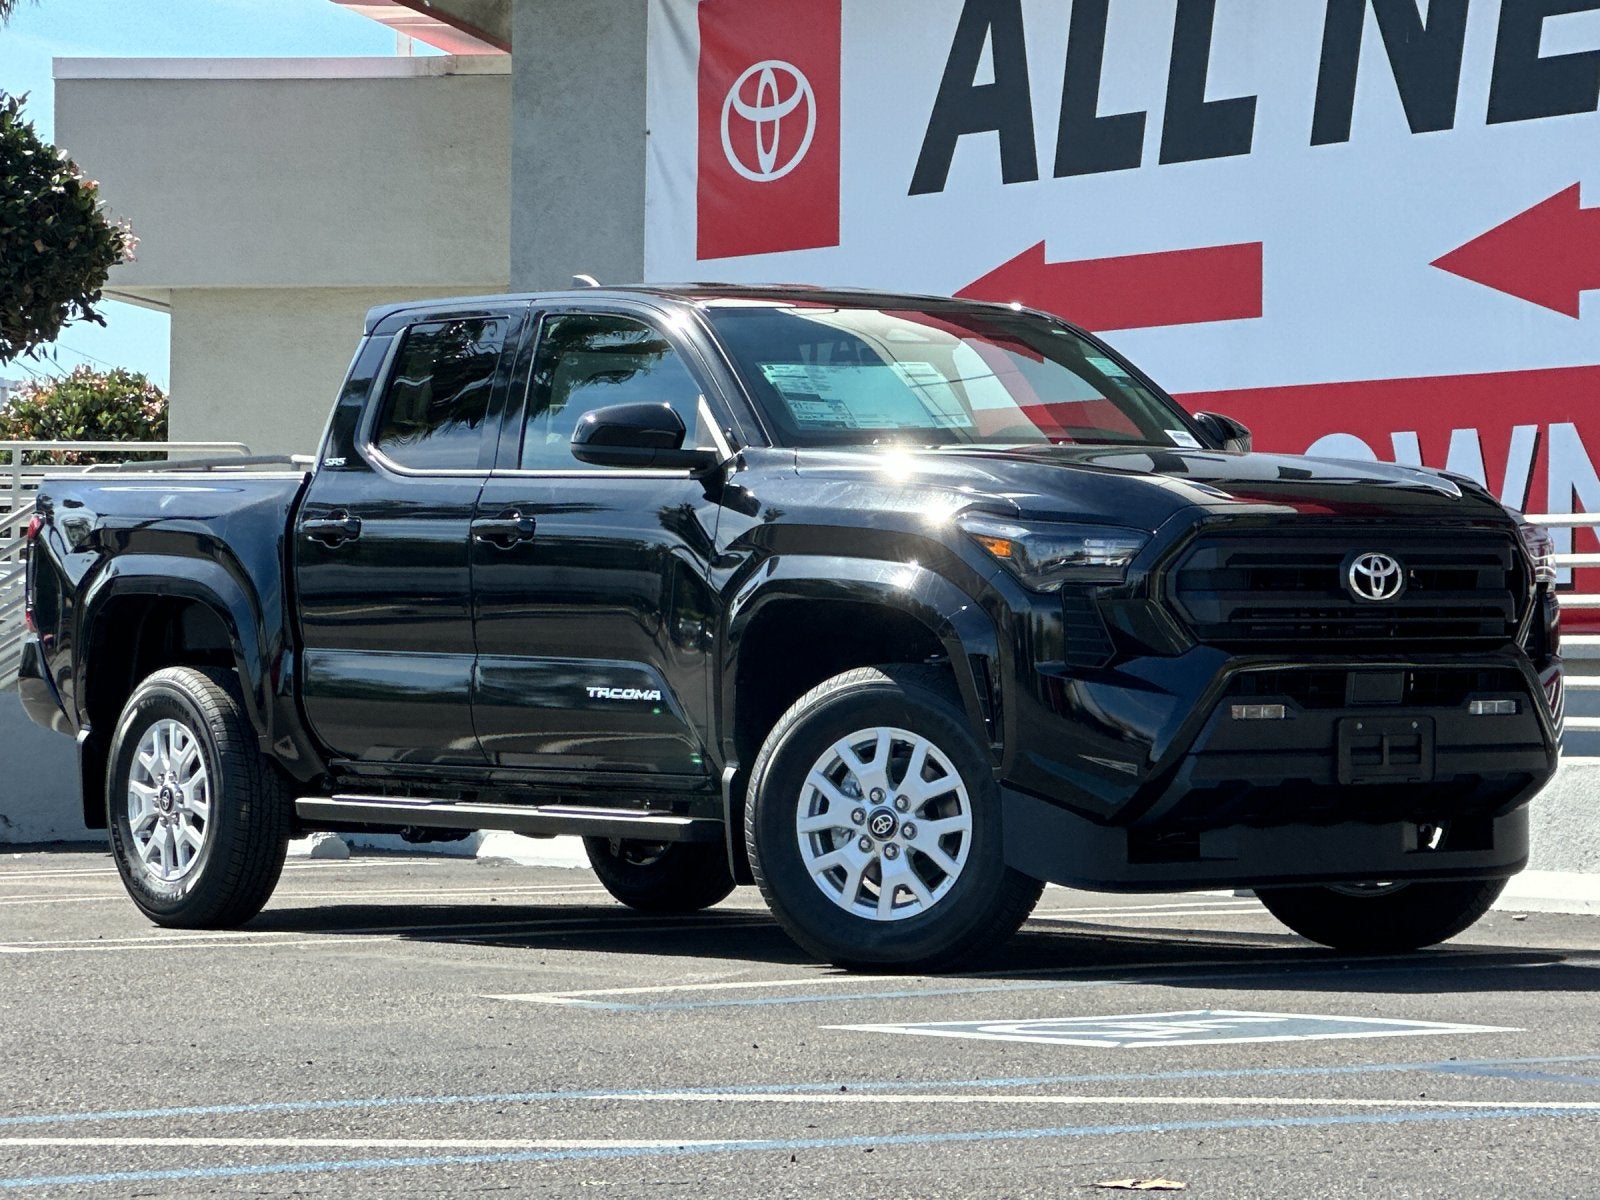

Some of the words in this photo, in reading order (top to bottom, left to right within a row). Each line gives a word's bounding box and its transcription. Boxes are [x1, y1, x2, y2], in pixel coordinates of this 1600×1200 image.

[907, 0, 1258, 197] ALL
[324, 457, 347, 467] SR5
[585, 686, 662, 701] TACOMA
